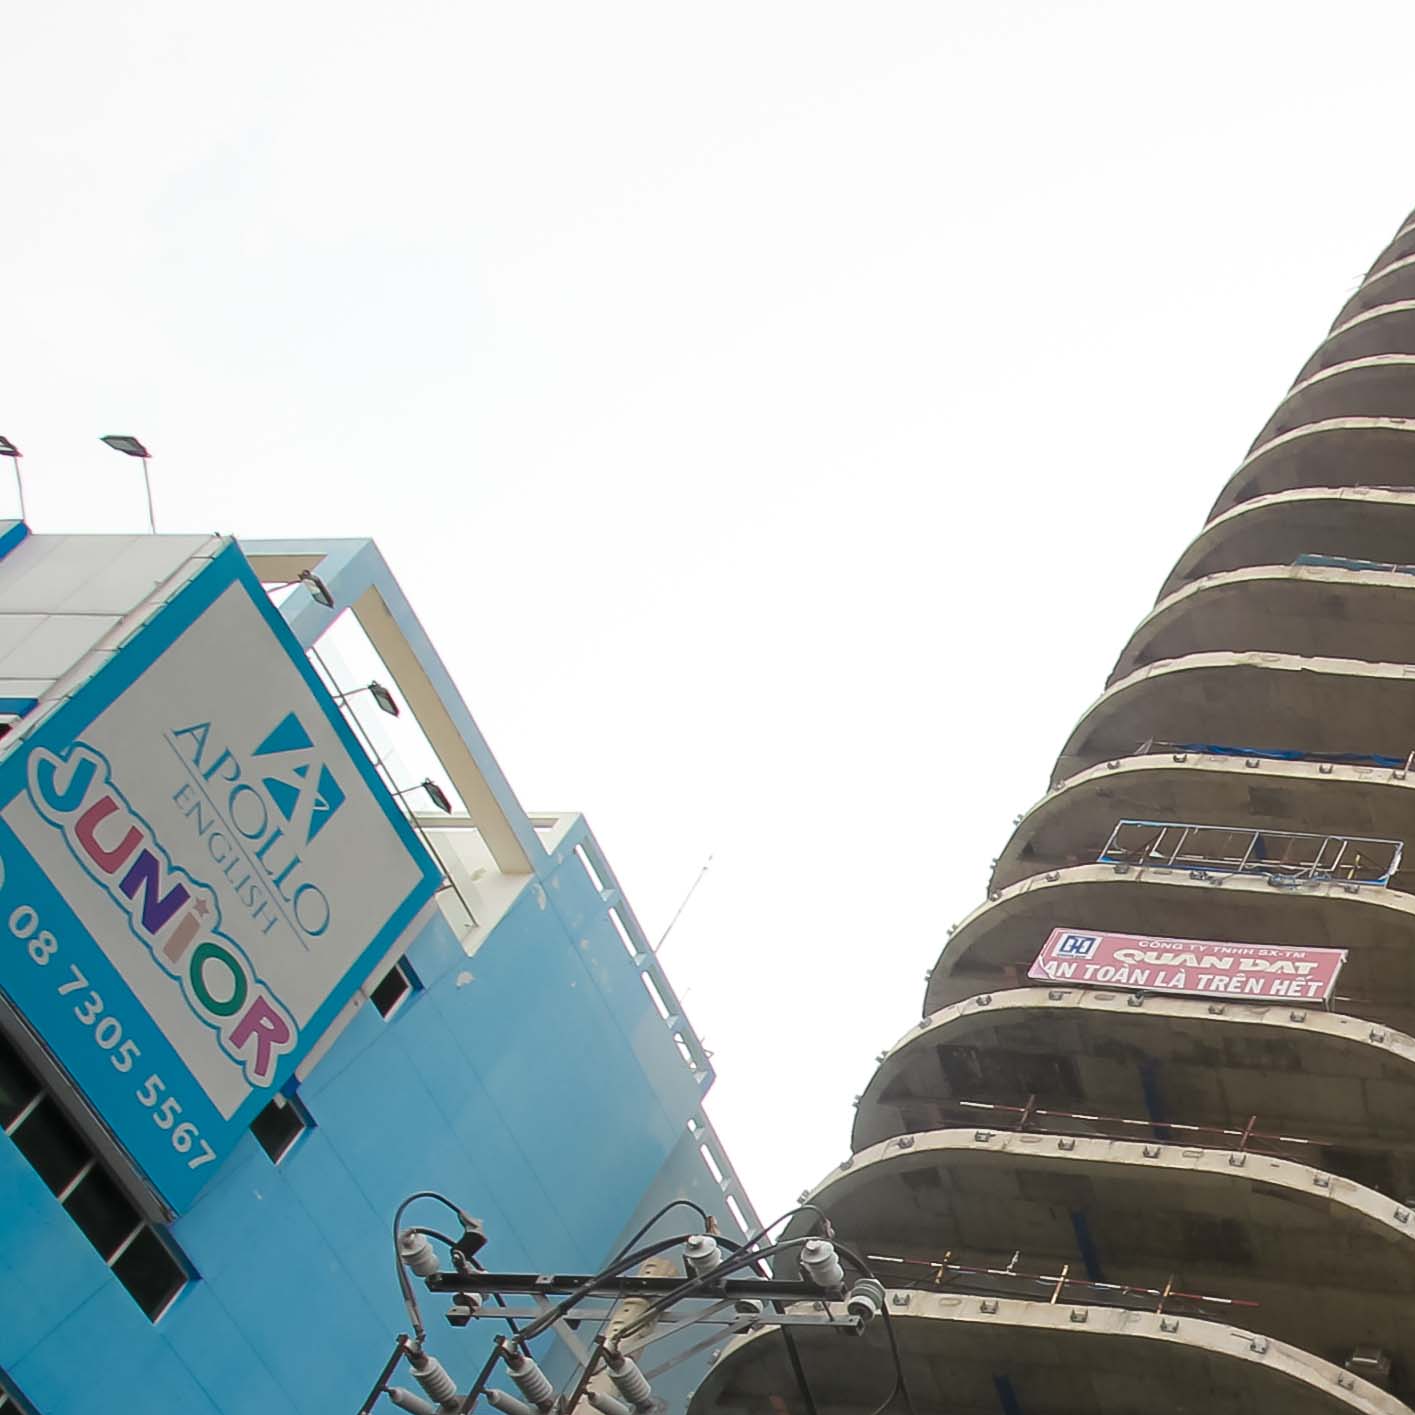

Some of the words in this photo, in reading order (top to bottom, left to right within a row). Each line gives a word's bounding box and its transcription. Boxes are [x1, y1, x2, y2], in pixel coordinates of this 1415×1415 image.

[172, 721, 330, 937] APOLLO
[173, 783, 279, 935] ENGLISH
[1043, 960, 1078, 978] AN
[1082, 963, 1150, 985] TOÀN
[1152, 967, 1187, 989] LÀ
[1196, 972, 1265, 994] TRÊN
[1269, 975, 1324, 998] HẾT
[1189, 943, 1208, 952] TY
[8, 904, 58, 966] 08
[57, 963, 141, 1073] 7305
[136, 1073, 217, 1170] 5567
